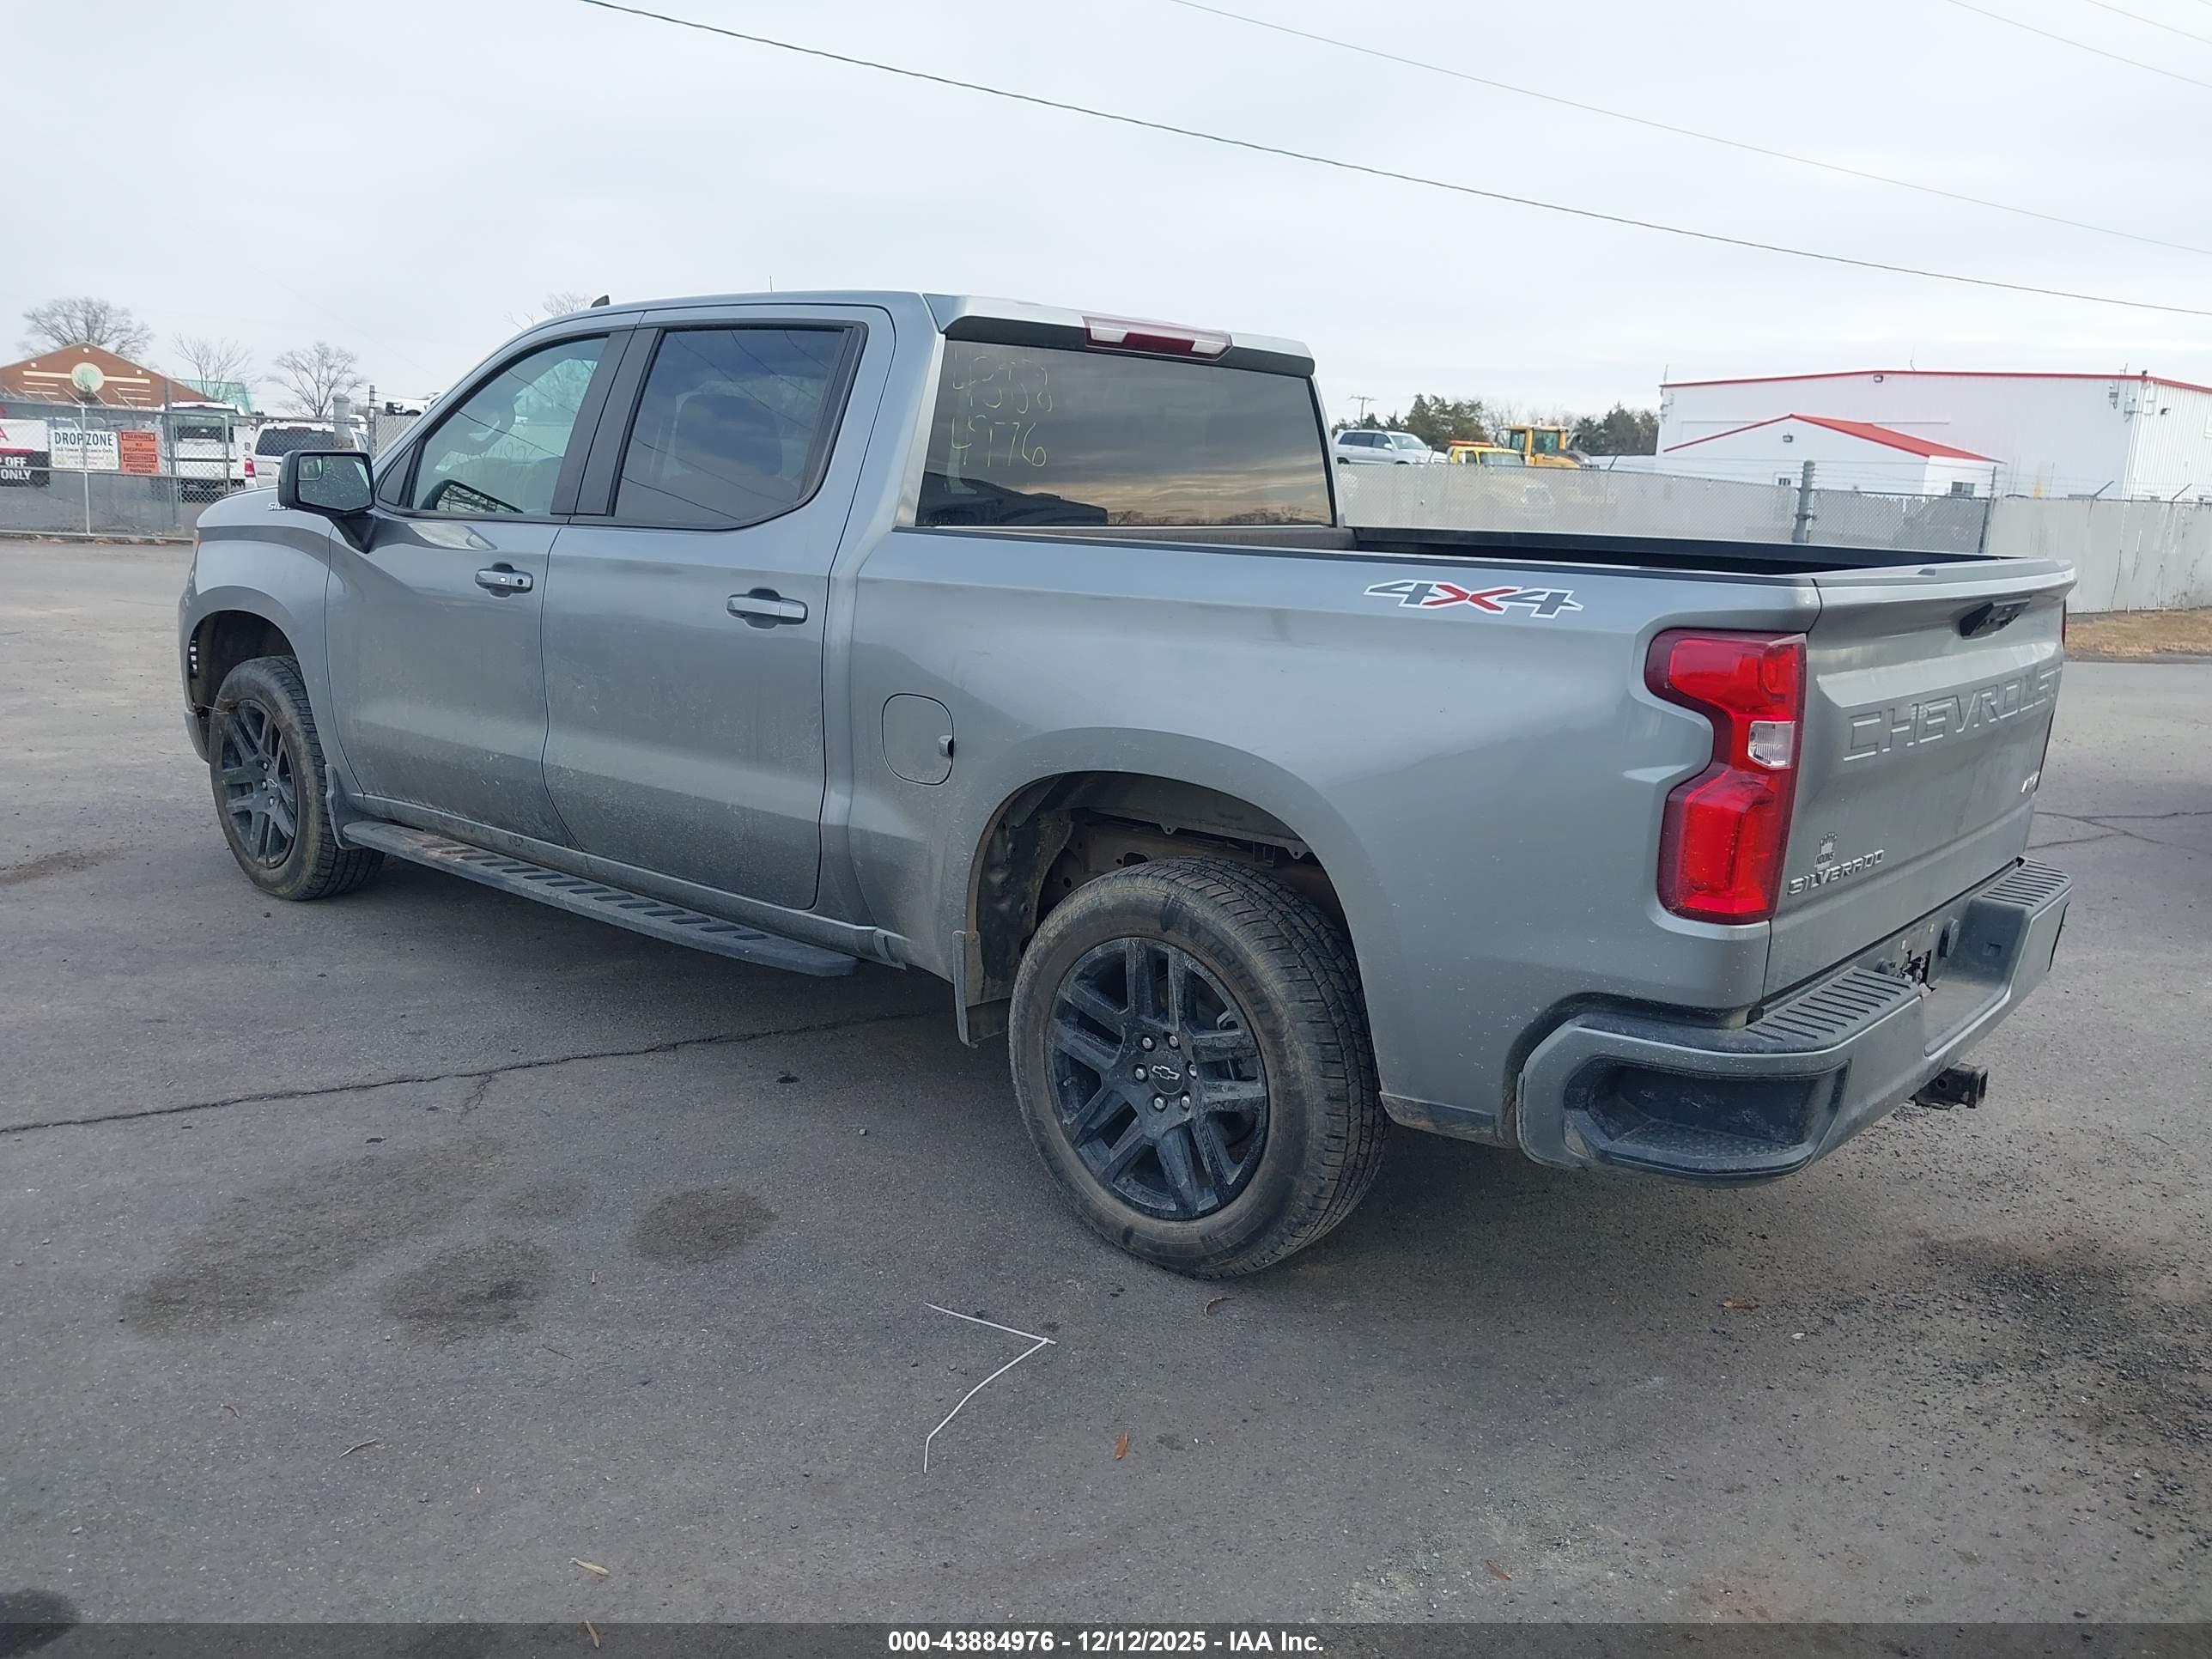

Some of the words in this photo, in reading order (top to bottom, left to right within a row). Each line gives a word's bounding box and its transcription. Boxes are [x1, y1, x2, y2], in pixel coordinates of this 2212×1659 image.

[54, 432, 83, 445] DROP
[86, 433, 113, 447] ZONE
[5, 456, 27, 467] OFF
[0, 469, 32, 480] ONLY
[1787, 848, 1885, 896] SILVERADO
